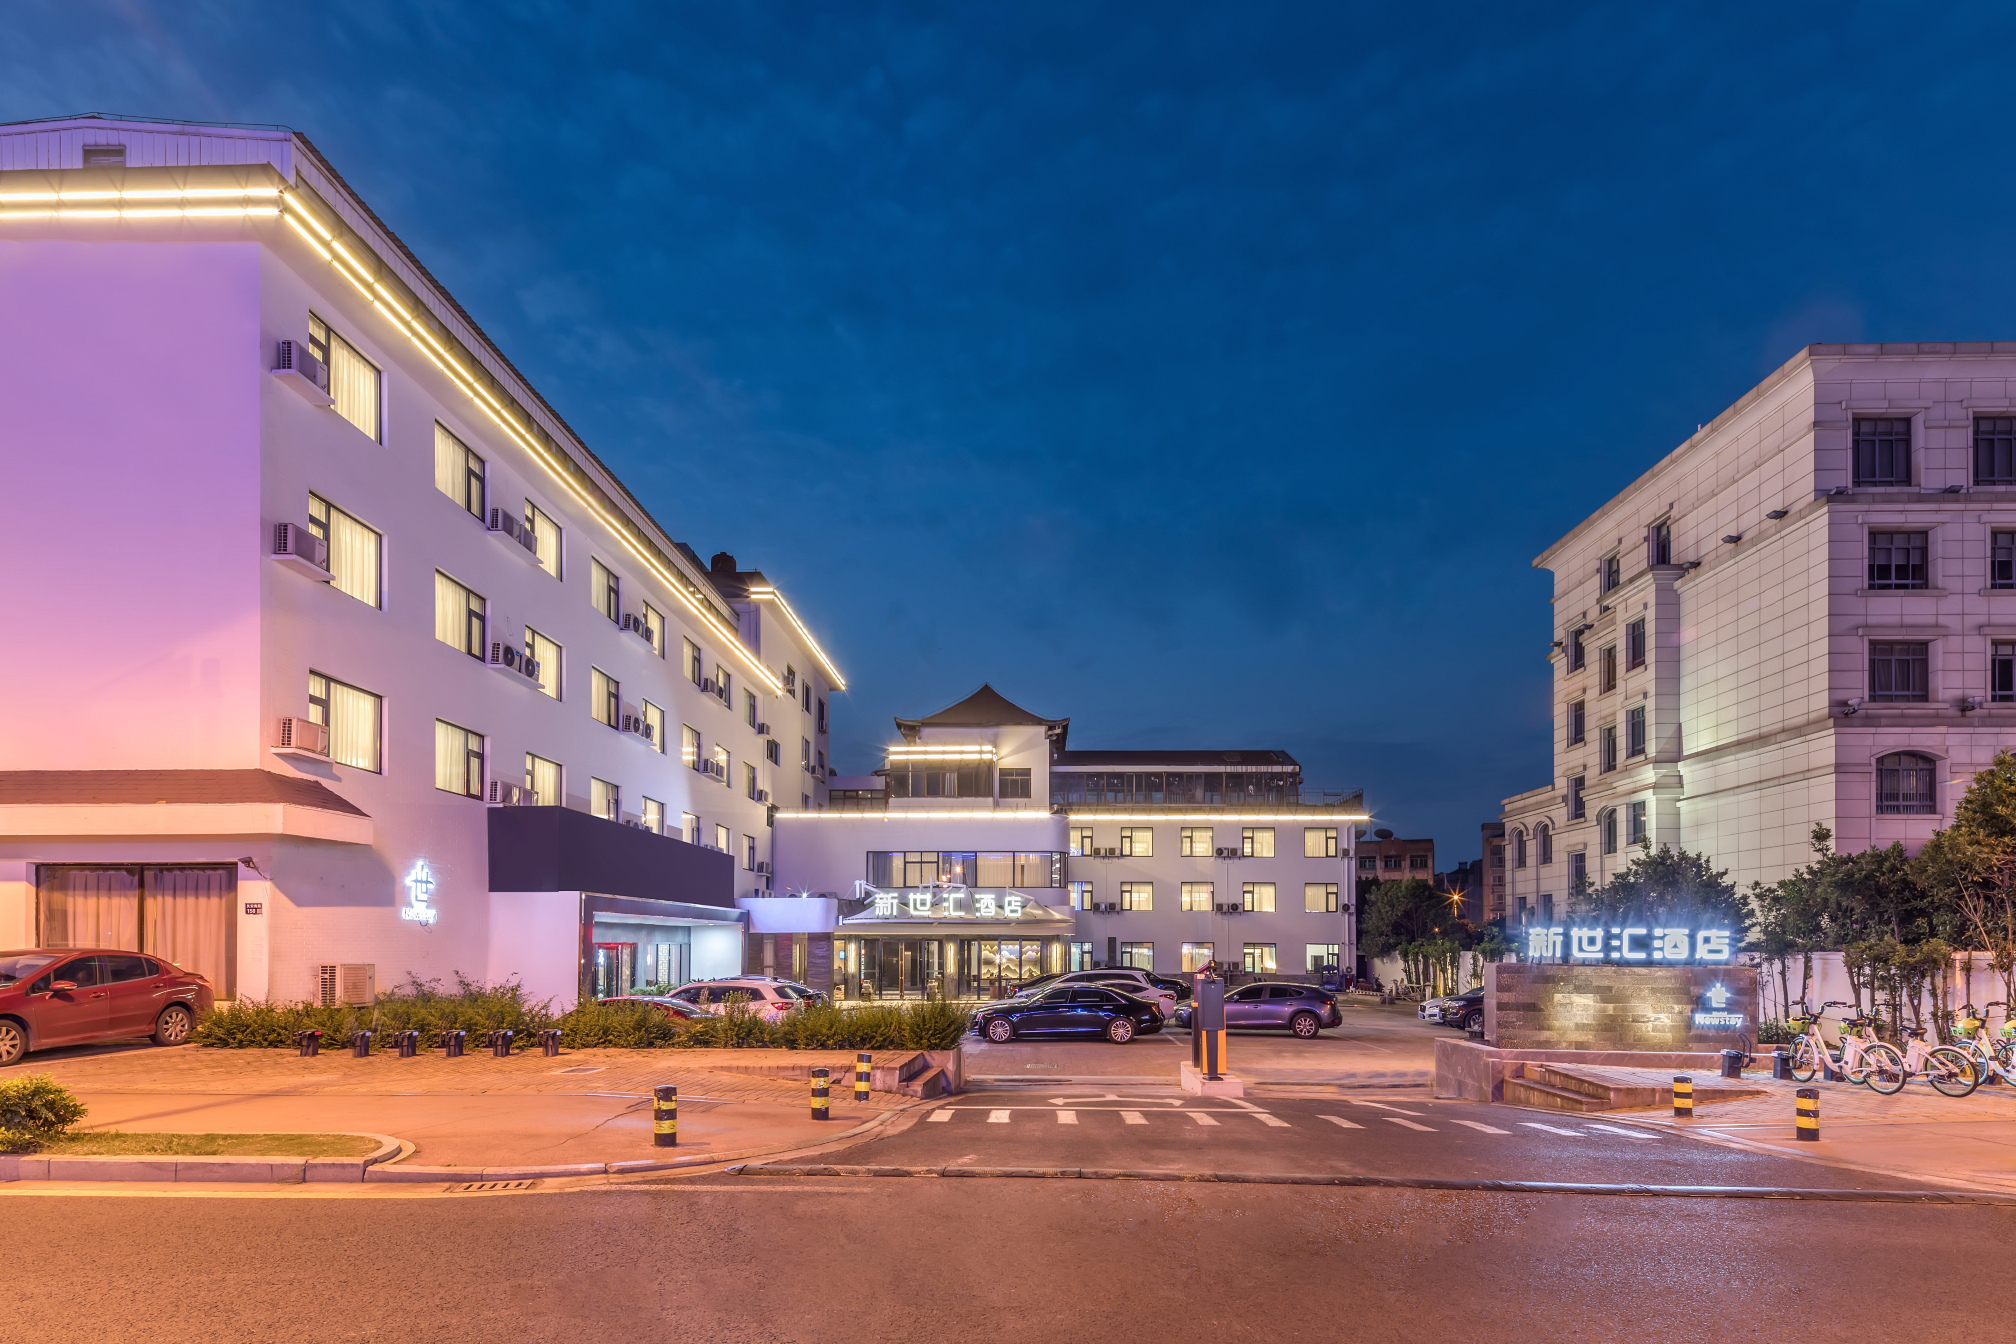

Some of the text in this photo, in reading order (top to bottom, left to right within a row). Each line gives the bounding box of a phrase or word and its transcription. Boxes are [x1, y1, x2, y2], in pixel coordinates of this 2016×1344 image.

[874, 892, 1023, 917] 新世汇酒店
[1528, 927, 1730, 960] 新世汇酒店
[1695, 1013, 1743, 1027] Newstay
